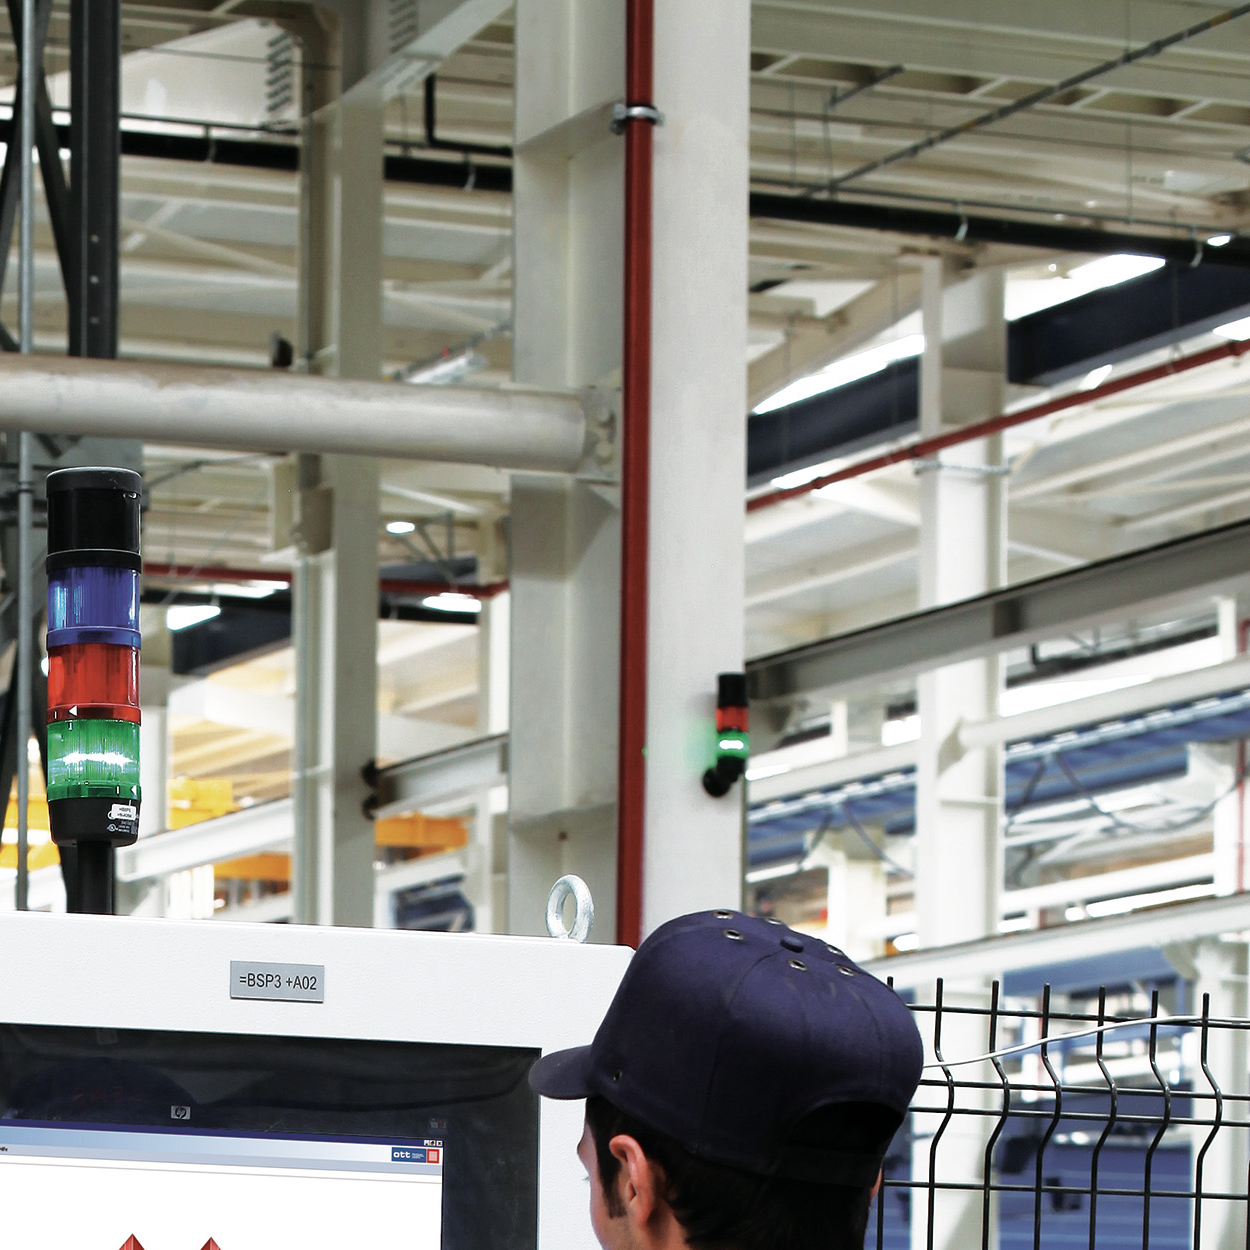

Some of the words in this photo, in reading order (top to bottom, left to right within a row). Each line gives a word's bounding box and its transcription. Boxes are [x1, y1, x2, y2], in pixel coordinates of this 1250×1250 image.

[239, 972, 282, 989] =BSP3
[285, 975, 317, 991] +A02
[393, 1151, 411, 1159] ott
